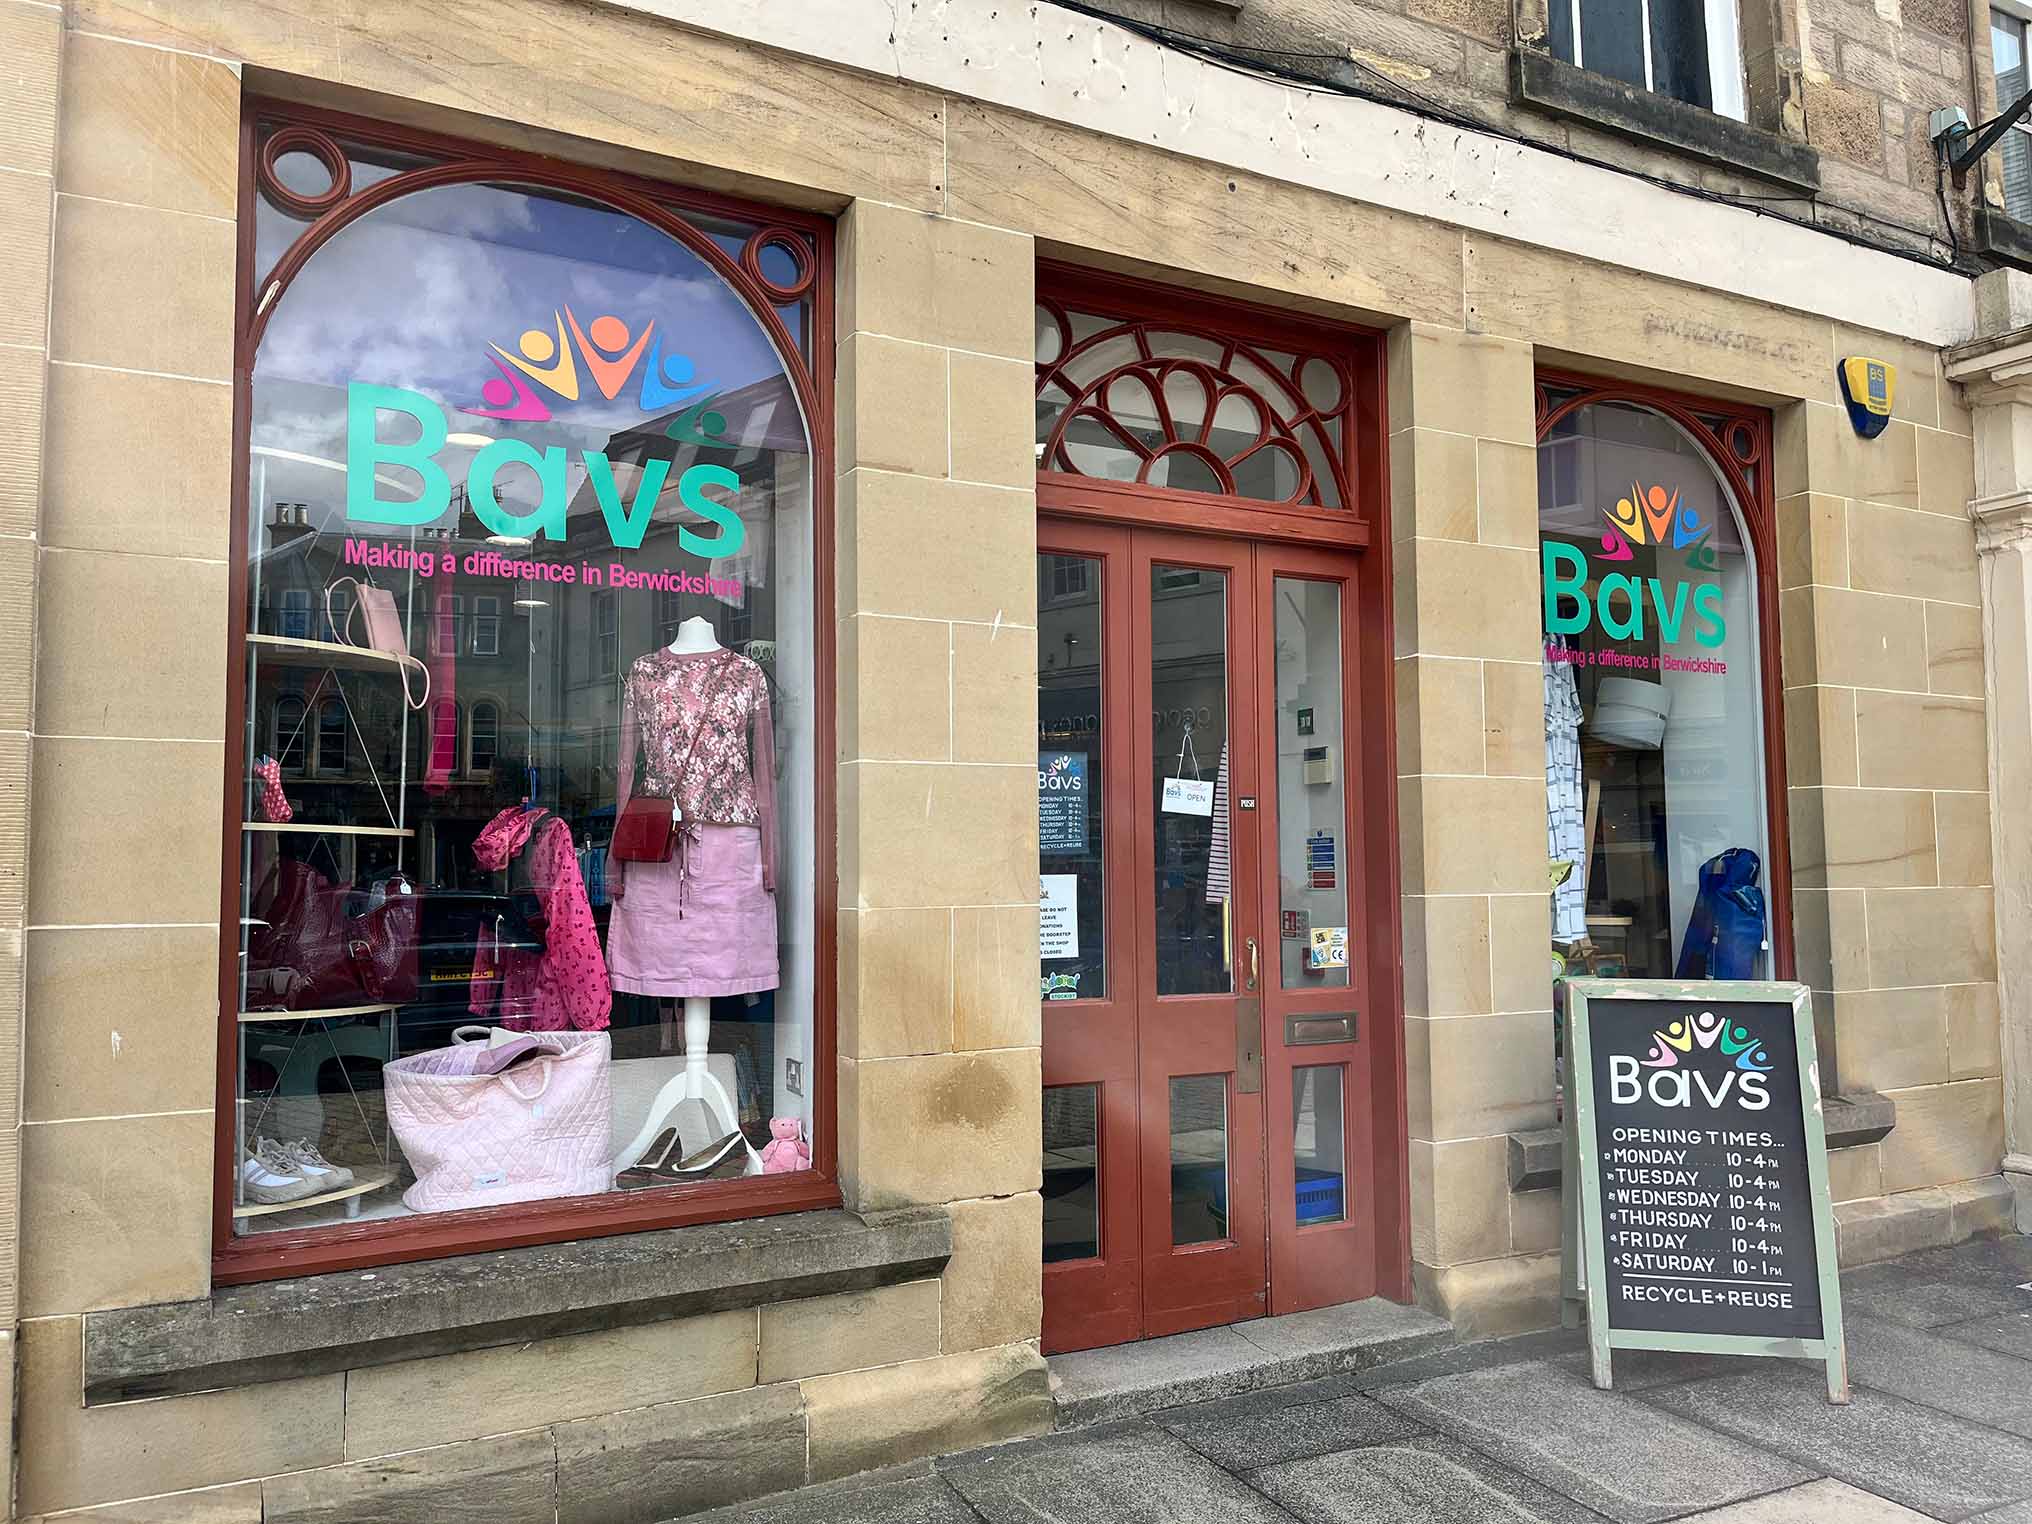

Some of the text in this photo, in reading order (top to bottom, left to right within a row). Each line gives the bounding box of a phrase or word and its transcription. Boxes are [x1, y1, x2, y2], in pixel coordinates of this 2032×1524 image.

[346, 382, 746, 560] Bavs
[344, 538, 743, 599] Making a difference in Berwickshire
[1543, 541, 1727, 648] Bavs
[1546, 644, 1727, 674] Making a difference in Berwickshire
[1039, 771, 1081, 790] Bavs
[1187, 794, 1206, 802] OPEN
[1608, 1055, 1770, 1110] Bavs
[1612, 1128, 1702, 1144] OPENING
[1613, 1149, 1687, 1165] MONDAY
[1615, 1168, 1699, 1187] TUESDAY
[1616, 1189, 1720, 1209] WEDNESDAY
[1618, 1209, 1712, 1229] THURSDAY
[1619, 1231, 1688, 1249] FRIDAY
[1621, 1253, 1715, 1273] SATURDAY
